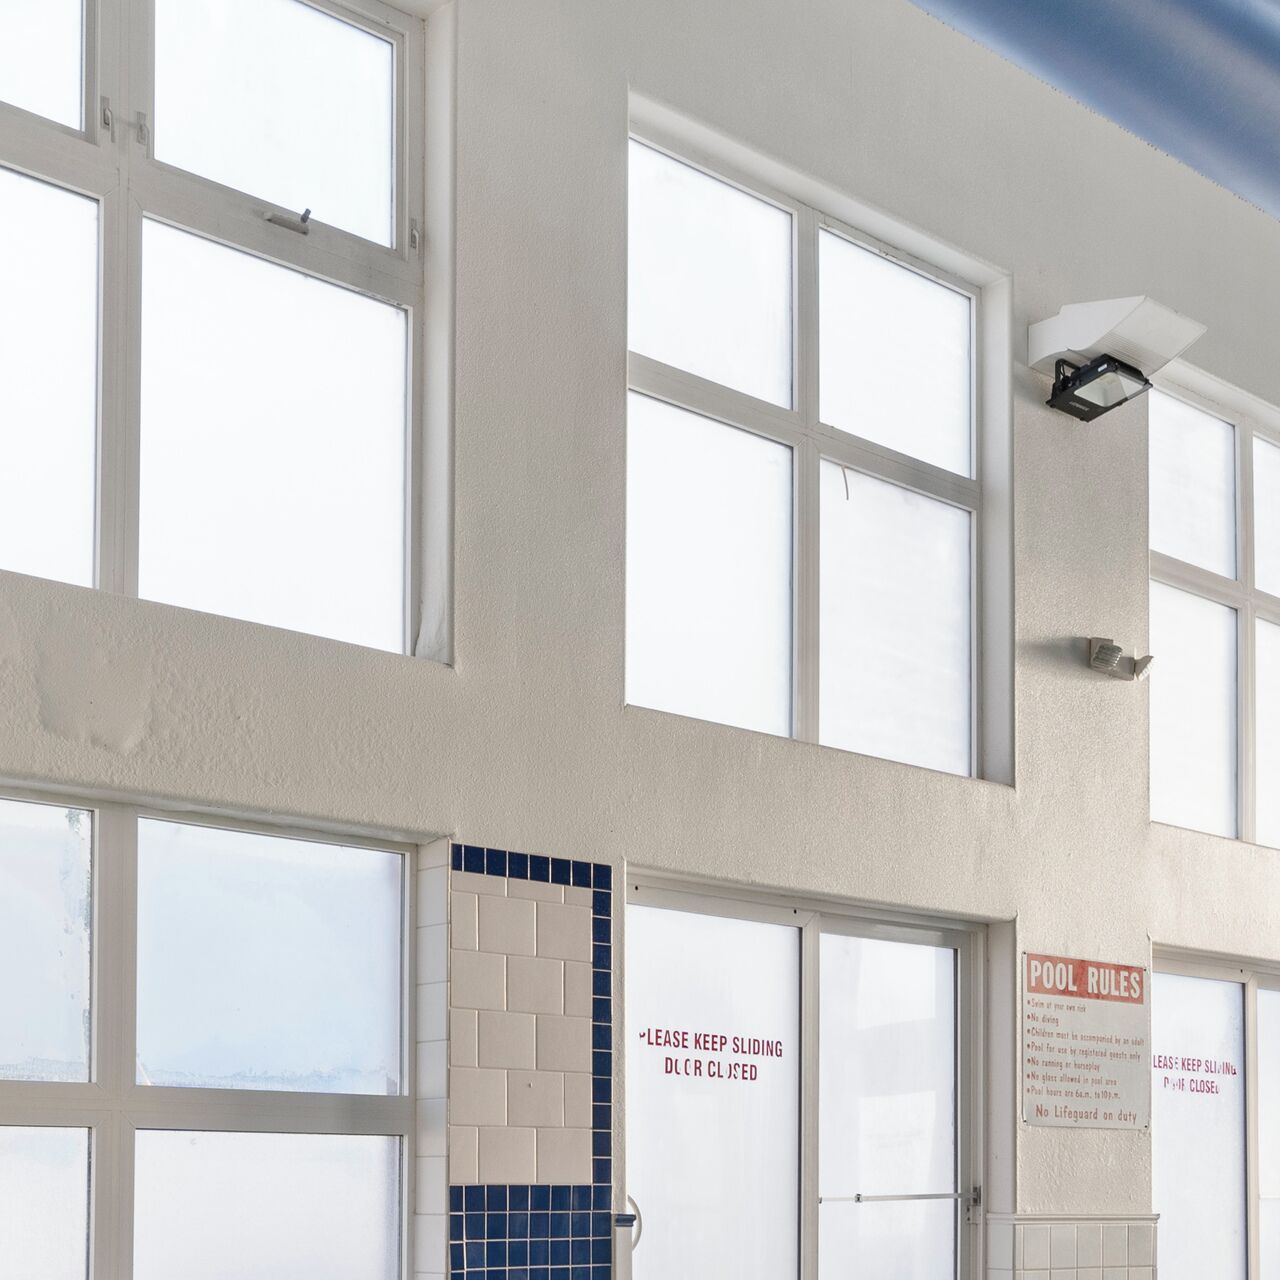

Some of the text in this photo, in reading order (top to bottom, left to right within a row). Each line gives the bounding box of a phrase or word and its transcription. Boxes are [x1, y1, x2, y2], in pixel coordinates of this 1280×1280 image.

[1030, 960, 1140, 999] POOL RULES
[1042, 1014, 1059, 1027] diving
[1031, 1026, 1054, 1038] Children
[639, 1028, 783, 1058] LEASE KEEP SLIDING
[1181, 1057, 1202, 1072] KEEP
[1036, 1104, 1137, 1124] No Lifeguard on duty
